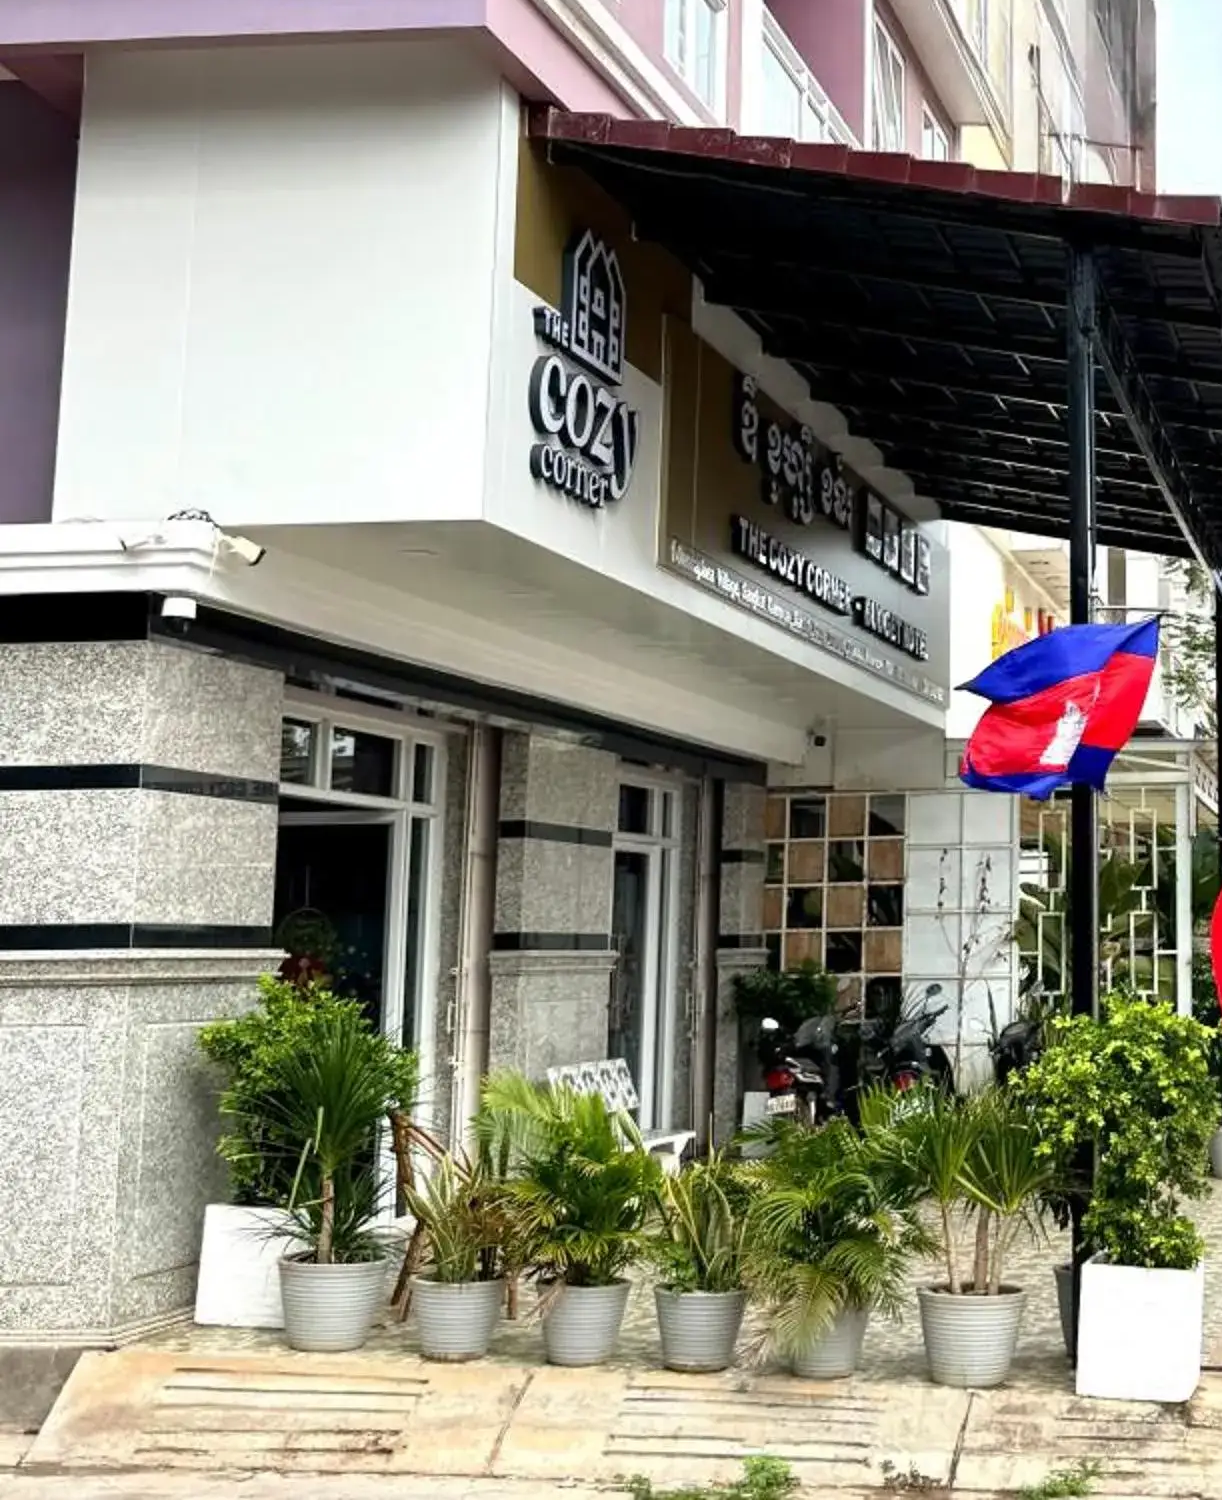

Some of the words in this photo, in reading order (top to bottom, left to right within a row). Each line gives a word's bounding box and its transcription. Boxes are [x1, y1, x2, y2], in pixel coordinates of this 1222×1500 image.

[543, 307, 569, 348] THE
[540, 444, 609, 509] corner
[739, 516, 768, 566] THE
[769, 536, 806, 587] COZY
